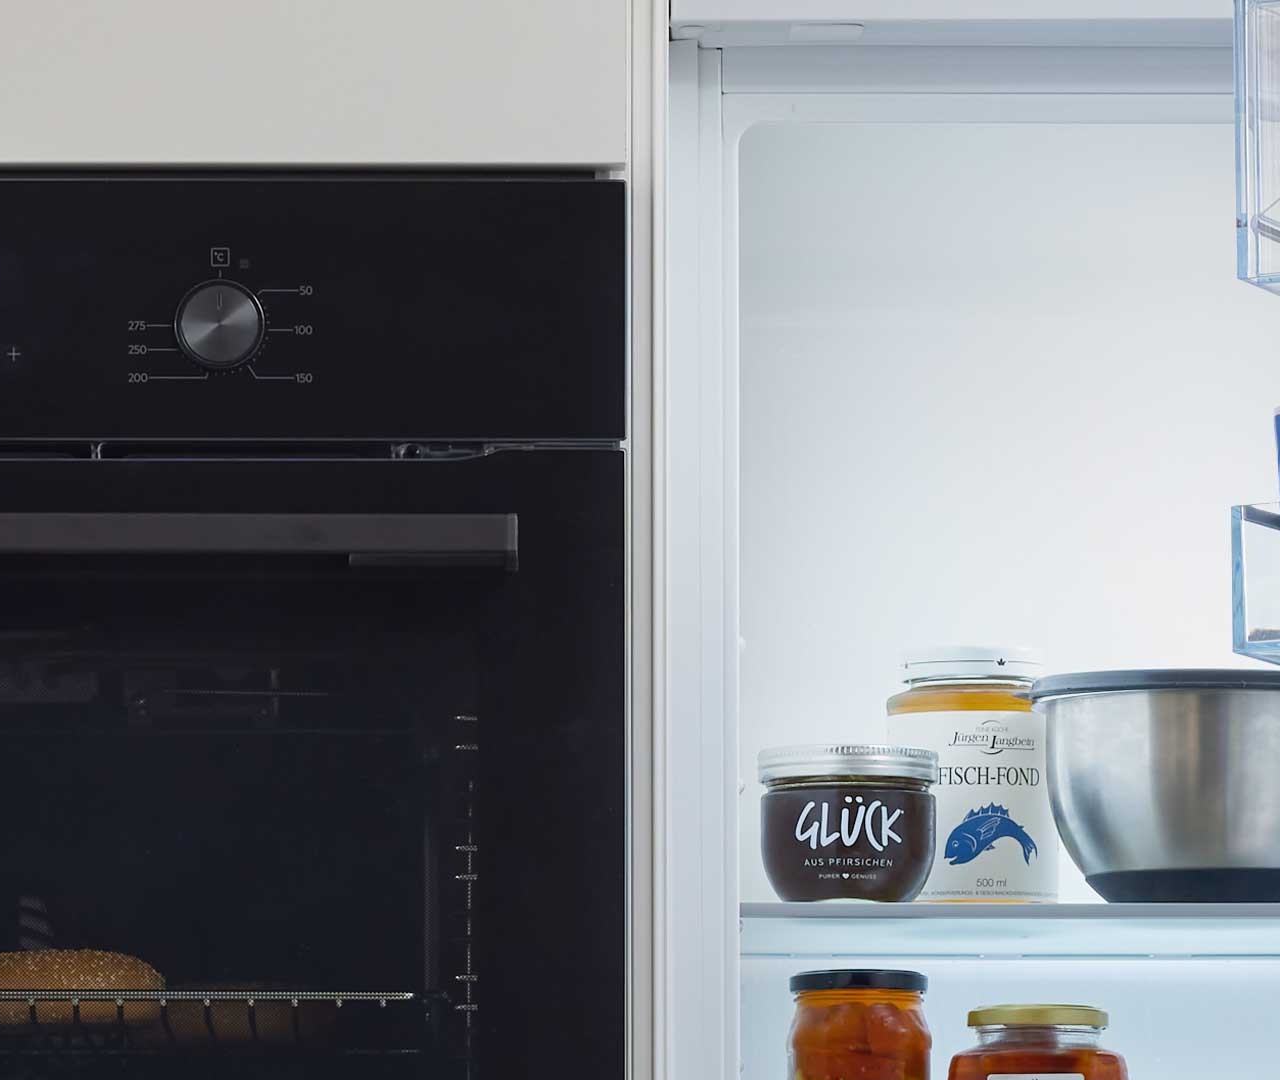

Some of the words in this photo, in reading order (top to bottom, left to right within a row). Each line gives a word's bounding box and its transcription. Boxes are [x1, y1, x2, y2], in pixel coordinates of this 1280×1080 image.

[299, 286, 313, 295] 50
[128, 321, 146, 331] 275
[294, 325, 313, 335] 100
[128, 345, 147, 355] 250
[128, 373, 148, 383] 200
[296, 373, 313, 383] 150
[949, 731, 989, 746] Jürgen
[939, 767, 1040, 786] FISCH-FOND
[795, 796, 903, 852] GLÜCK
[804, 858, 824, 867] AUS
[828, 858, 894, 867] PFIRSICHEN
[976, 878, 994, 887] 500
[996, 878, 1007, 887] ml
